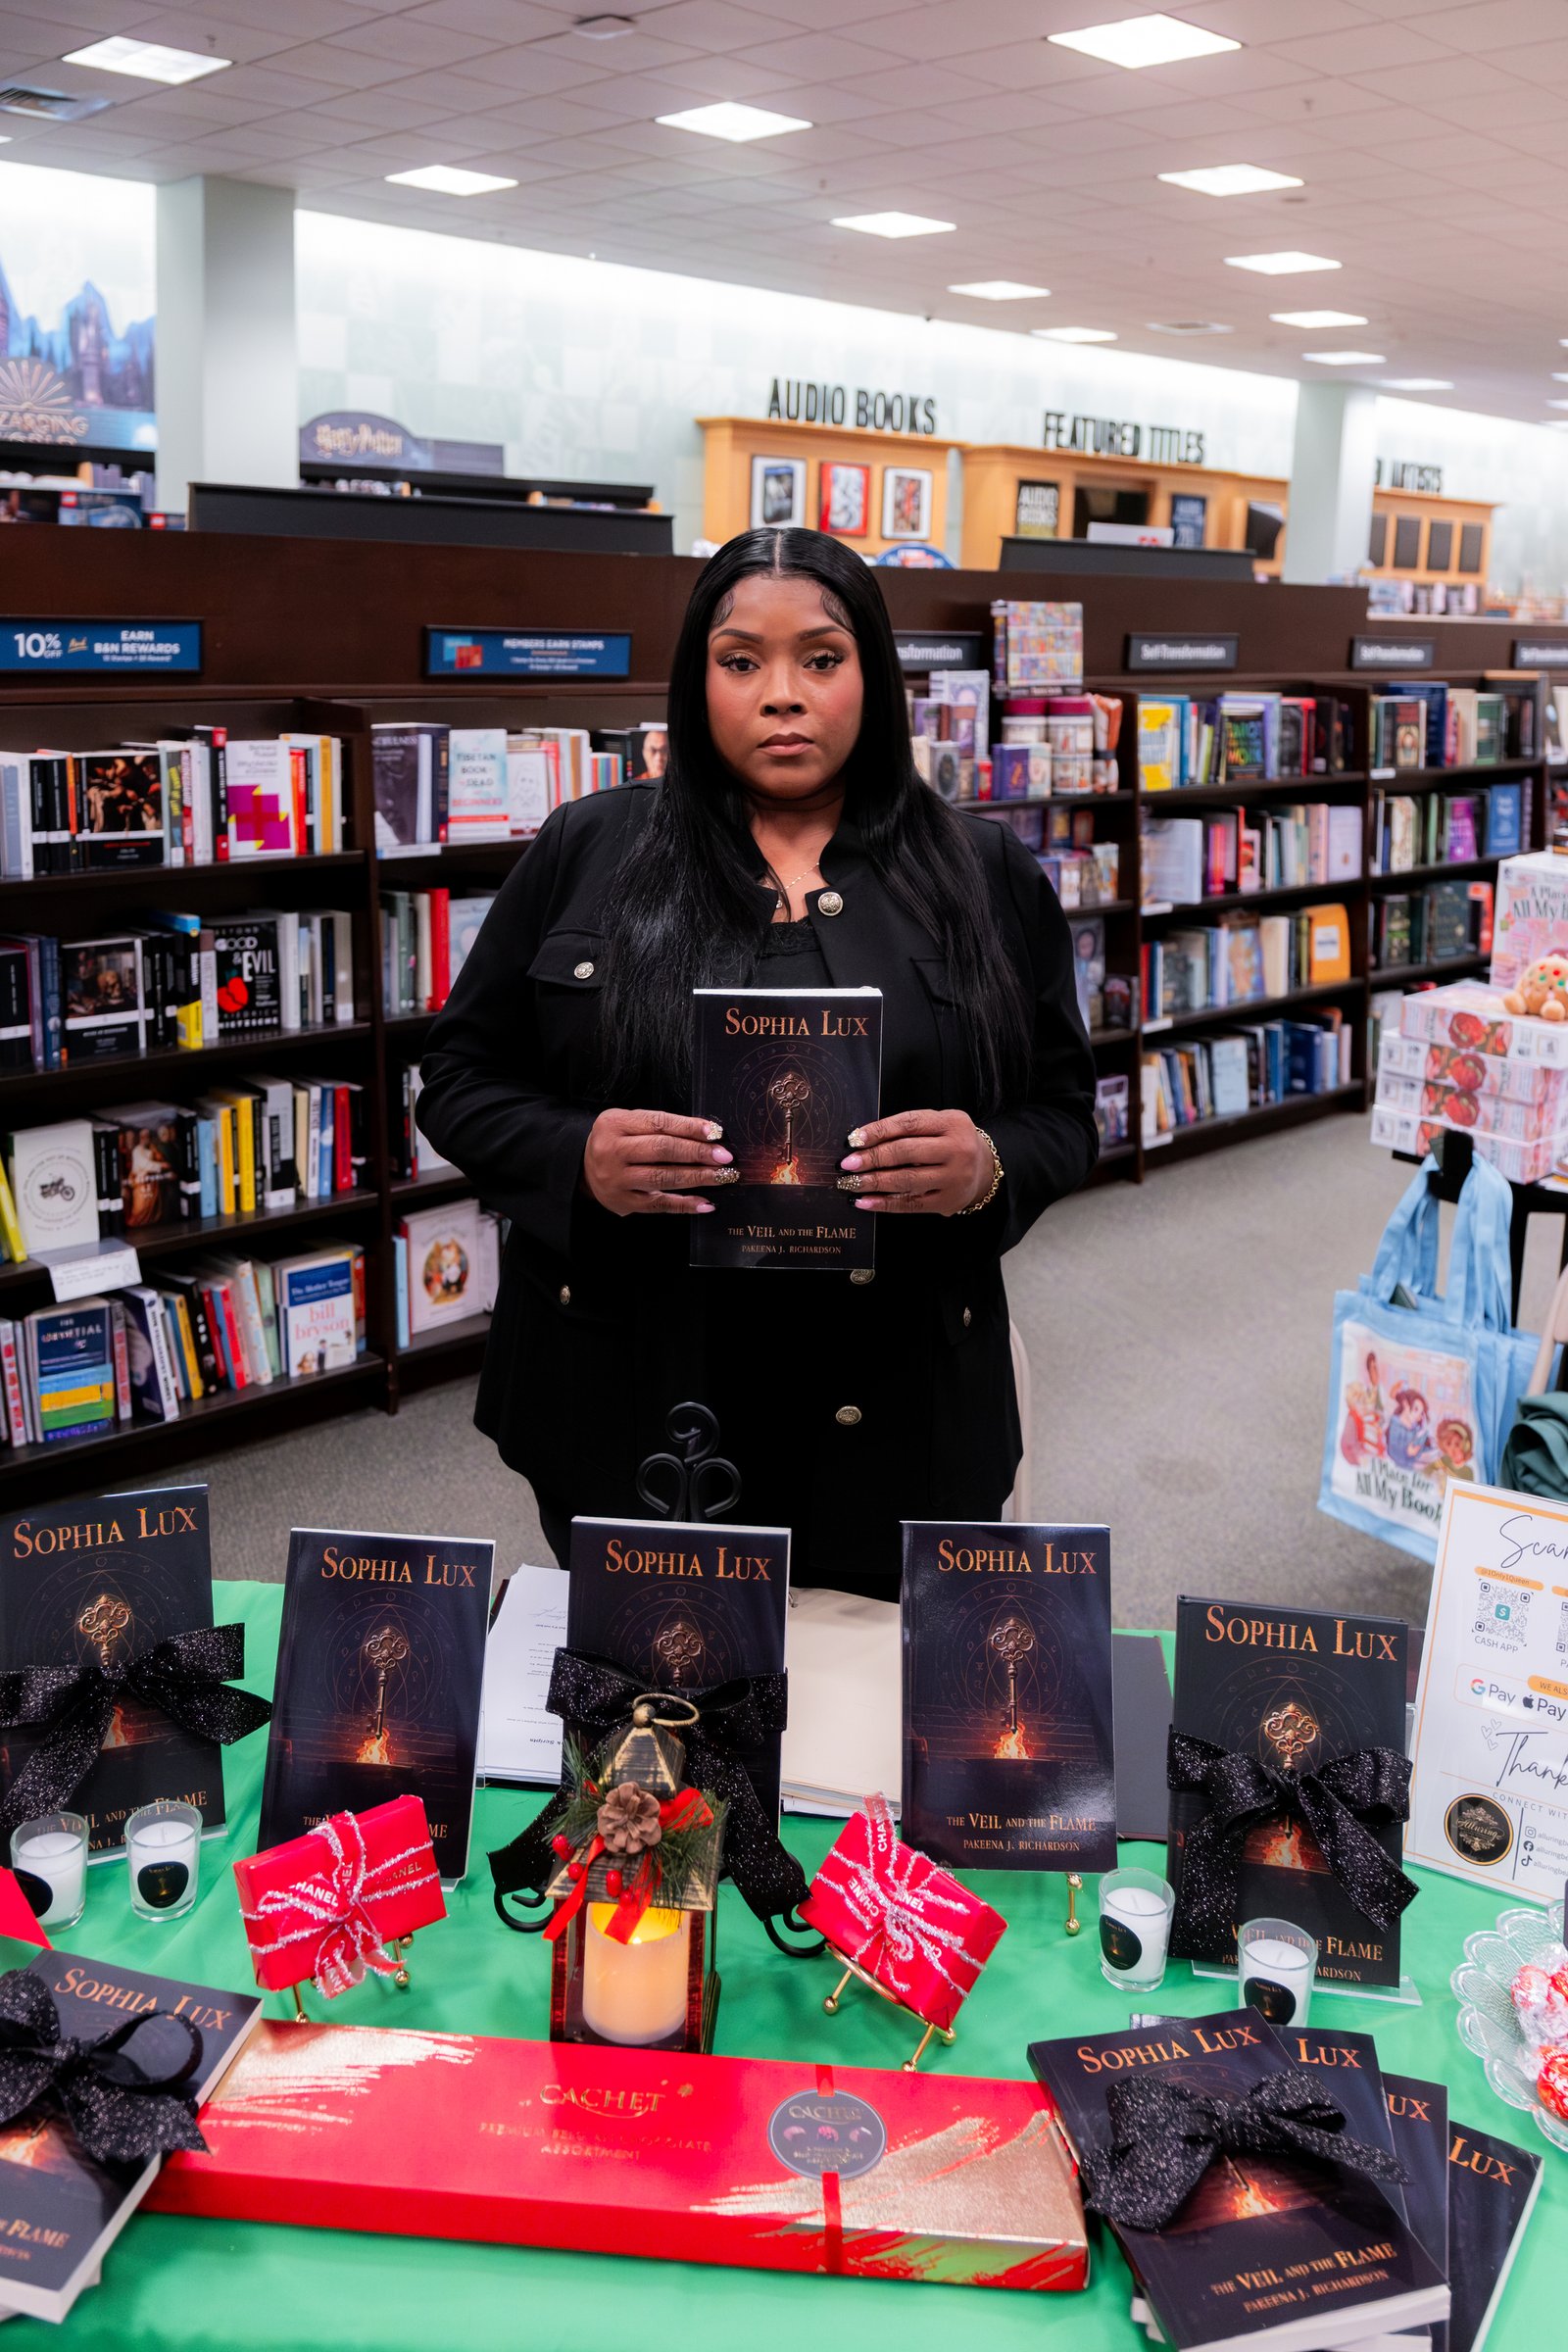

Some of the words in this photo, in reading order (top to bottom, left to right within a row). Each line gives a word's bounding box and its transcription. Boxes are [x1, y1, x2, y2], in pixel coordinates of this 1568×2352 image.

[768, 377, 845, 425] AUDIO
[856, 389, 936, 434] BOOKS
[1044, 411, 1141, 457] FEATURED
[1150, 426, 1203, 465] TITLES
[121, 630, 155, 642] EARN
[121, 642, 181, 655] REWARDS
[897, 644, 963, 662] nsformation
[725, 1007, 810, 1036] SOPHIA
[820, 1010, 869, 1037] LUX
[728, 1227, 744, 1236] THE
[747, 1225, 775, 1238] VEIL
[797, 1228, 813, 1237] THE
[815, 1226, 857, 1239] FLAME
[742, 1245, 776, 1253] PAKEENA
[789, 1246, 841, 1254] RICHARDSON
[13, 1520, 125, 1560] SOPHIA
[137, 1506, 199, 1540] LUX
[320, 1546, 414, 1585] SOPHIA
[423, 1554, 478, 1588] LUX
[606, 1540, 704, 1578] SOPHIA
[714, 1546, 771, 1582] LUX
[938, 1539, 1033, 1573] SOPHIA
[1043, 1543, 1097, 1575] LUX
[1205, 1604, 1319, 1653] SOPHIA
[1332, 1618, 1398, 1663] LUX
[1474, 1635, 1498, 1649] CASH
[1499, 1642, 1519, 1654] APP
[1488, 1684, 1517, 1707] Pay
[1540, 1681, 1552, 1692] WE
[1552, 1685, 1568, 1695] ALS
[1537, 1697, 1567, 1722] Pay
[104, 1810, 127, 1824] AND
[1492, 1791, 1544, 1813] CONNECT
[1548, 1808, 1568, 1820] WIT
[946, 1816, 965, 1827] THE
[968, 1813, 1002, 1830] VEIL
[1005, 1817, 1025, 1828] AND
[1028, 1817, 1047, 1829] THE
[1049, 1814, 1097, 1832] FLAME
[963, 1838, 1004, 1850] PAKEENA
[1018, 1840, 1081, 1851] RICHARDSON
[1326, 1935, 1383, 1962] FLAME
[1316, 1965, 1362, 1982] ARDSON
[1077, 2039, 1191, 2075] SOPHIA
[1191, 2025, 1262, 2054] LUX
[1297, 2036, 1362, 2070] LUX
[539, 2083, 666, 2114] CACHET
[1387, 2093, 1432, 2123] UX
[1447, 2134, 1518, 2187] LUX
[1210, 2280, 1238, 2296] THE
[1235, 2268, 1285, 2291] VEIL
[1284, 2263, 1311, 2278] AND
[1309, 2257, 1337, 2273] THE
[1334, 2241, 1398, 2270] FLAME
[1311, 2268, 1391, 2297] RICHARDSON
